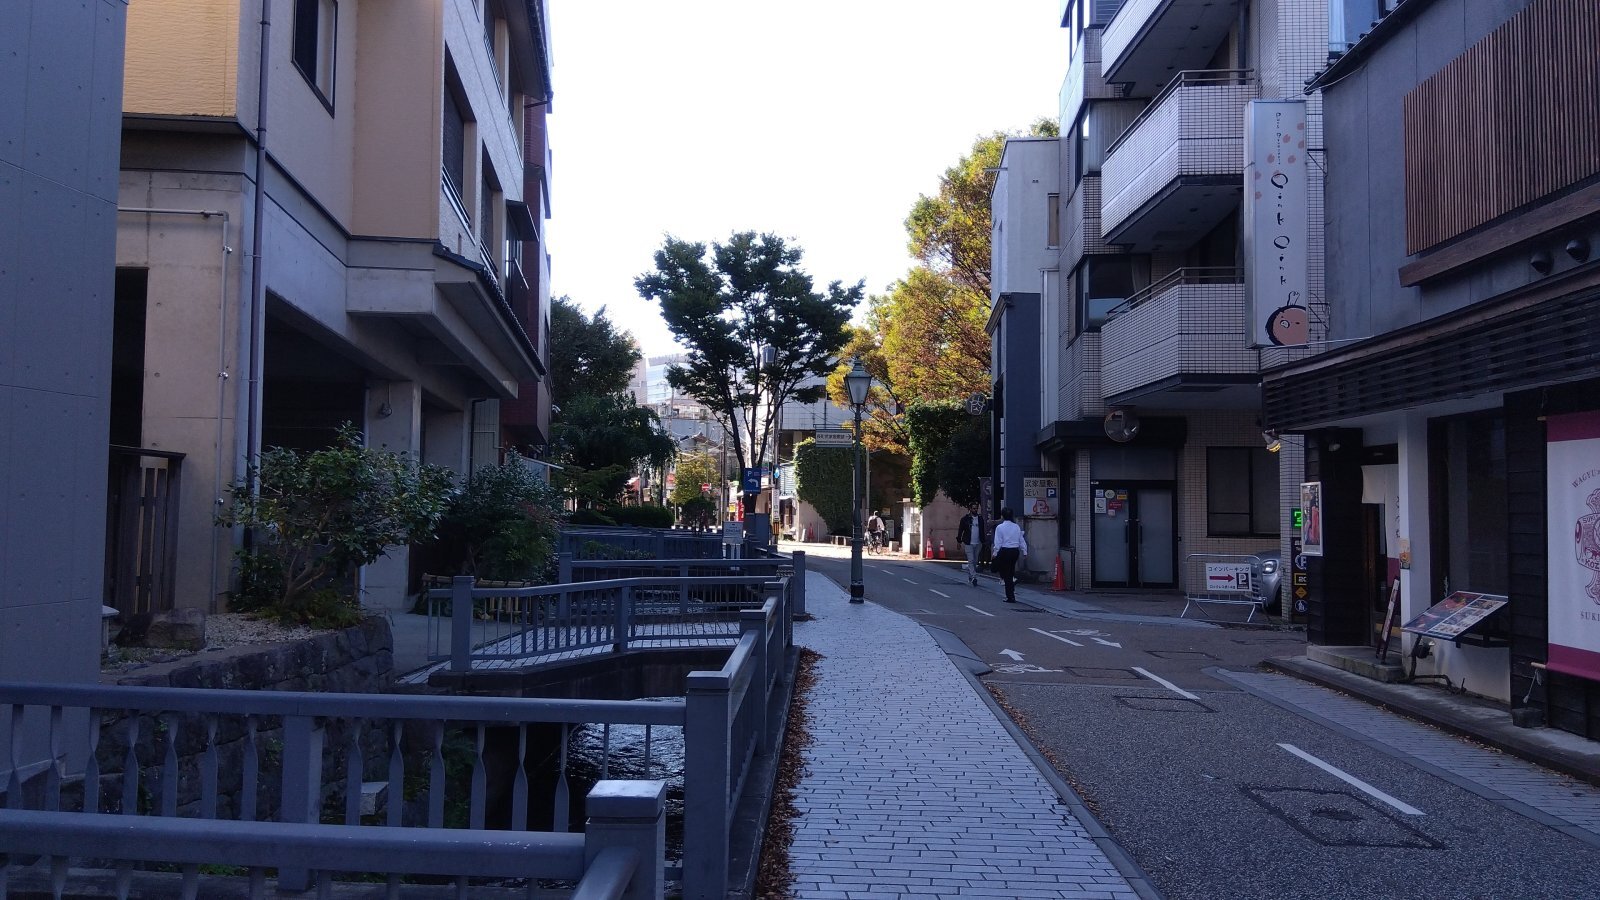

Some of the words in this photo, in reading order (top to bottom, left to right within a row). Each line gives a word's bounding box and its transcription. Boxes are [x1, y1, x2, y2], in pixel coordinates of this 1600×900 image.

[1271, 173, 1288, 225] Oink
[1274, 236, 1290, 286] Oink
[1047, 488, 1055, 497] P
